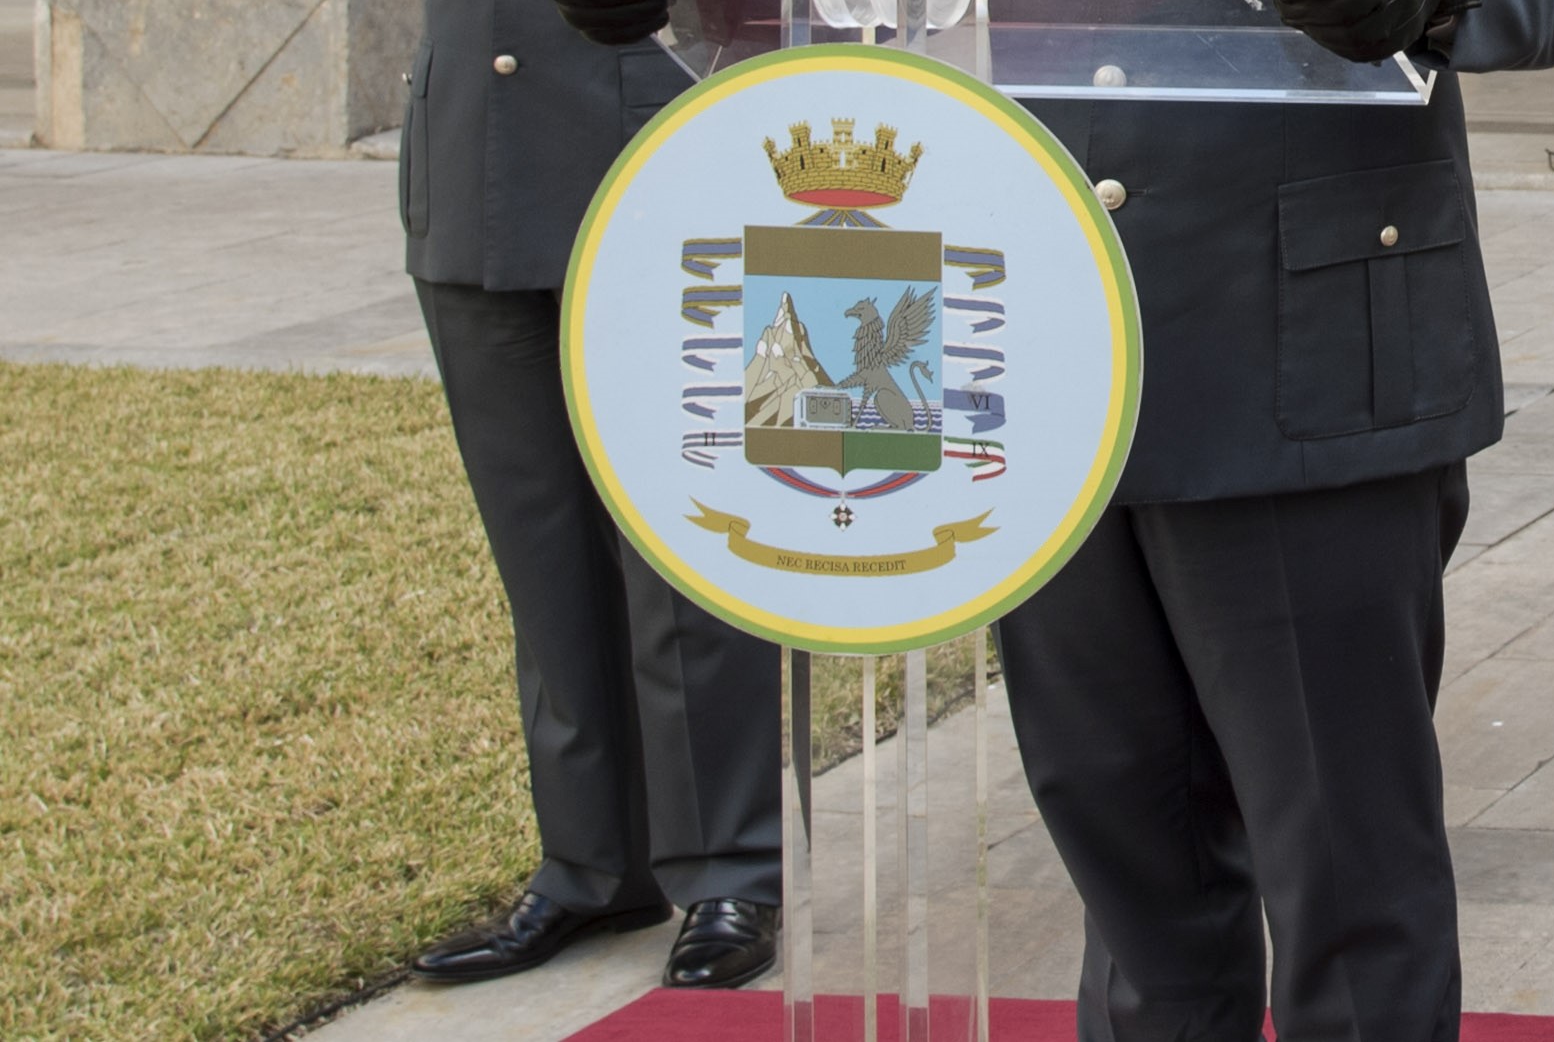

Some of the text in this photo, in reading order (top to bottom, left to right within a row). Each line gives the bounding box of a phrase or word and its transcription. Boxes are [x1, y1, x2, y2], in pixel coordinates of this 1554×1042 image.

[970, 393, 991, 410] VI
[972, 442, 990, 457] IX
[776, 555, 907, 573] NEC RECISA RECEDIT
